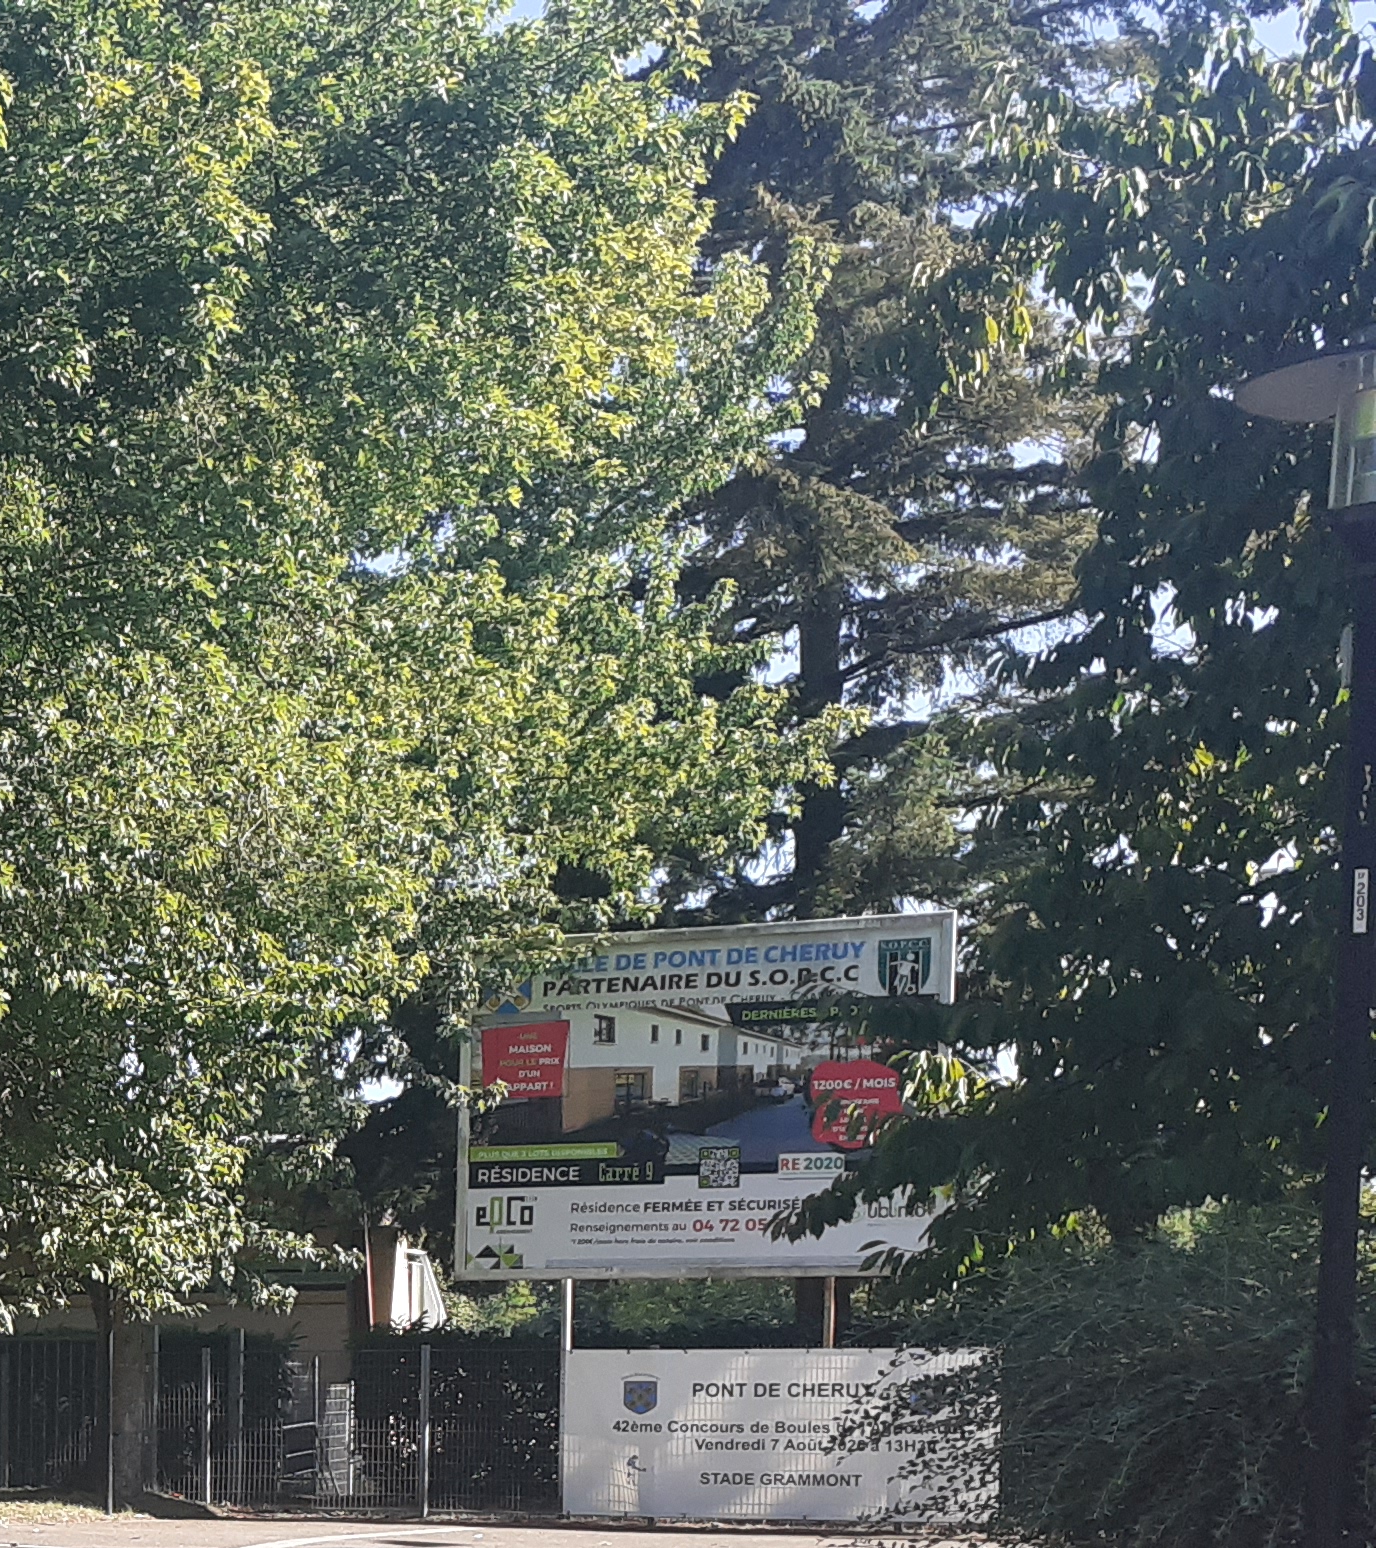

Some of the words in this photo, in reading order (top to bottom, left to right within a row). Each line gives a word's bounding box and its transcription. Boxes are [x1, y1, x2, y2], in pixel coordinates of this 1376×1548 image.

[1356, 882, 1366, 921] 203
[615, 953, 647, 971] DE
[653, 949, 721, 969] PONT
[726, 946, 758, 966] DE
[763, 940, 866, 963] CHERUY
[542, 973, 699, 998] PARTENAIRE
[705, 969, 742, 988] DU
[508, 1043, 552, 1054] MAISON
[538, 1057, 560, 1066] PRIX
[862, 1077, 896, 1089] MOIS
[780, 1157, 801, 1171] RE
[803, 1156, 844, 1171] 2020
[477, 1165, 581, 1184] RÉSIDENCE
[598, 1162, 640, 1183] Carré
[570, 1201, 641, 1213] Résidence
[643, 1198, 703, 1213] FERMÉE
[706, 1200, 724, 1212] ET
[728, 1196, 804, 1211] SÉCURISÉ
[569, 1221, 669, 1234] Renseignements
[671, 1222, 687, 1231] au
[692, 1219, 715, 1232] 04
[719, 1218, 740, 1231] 72
[745, 1218, 767, 1231] 05
[692, 1382, 748, 1398] PONT
[753, 1382, 781, 1398] DE
[612, 1420, 663, 1433] 42ème
[667, 1420, 745, 1433] Concours
[750, 1420, 769, 1433] de
[774, 1420, 831, 1433] Boules
[695, 1438, 766, 1451] Vendredi
[770, 1438, 780, 1451] 7
[784, 1438, 822, 1451] Août
[700, 1472, 755, 1486] STADE
[759, 1472, 863, 1488] GRAMMONT
